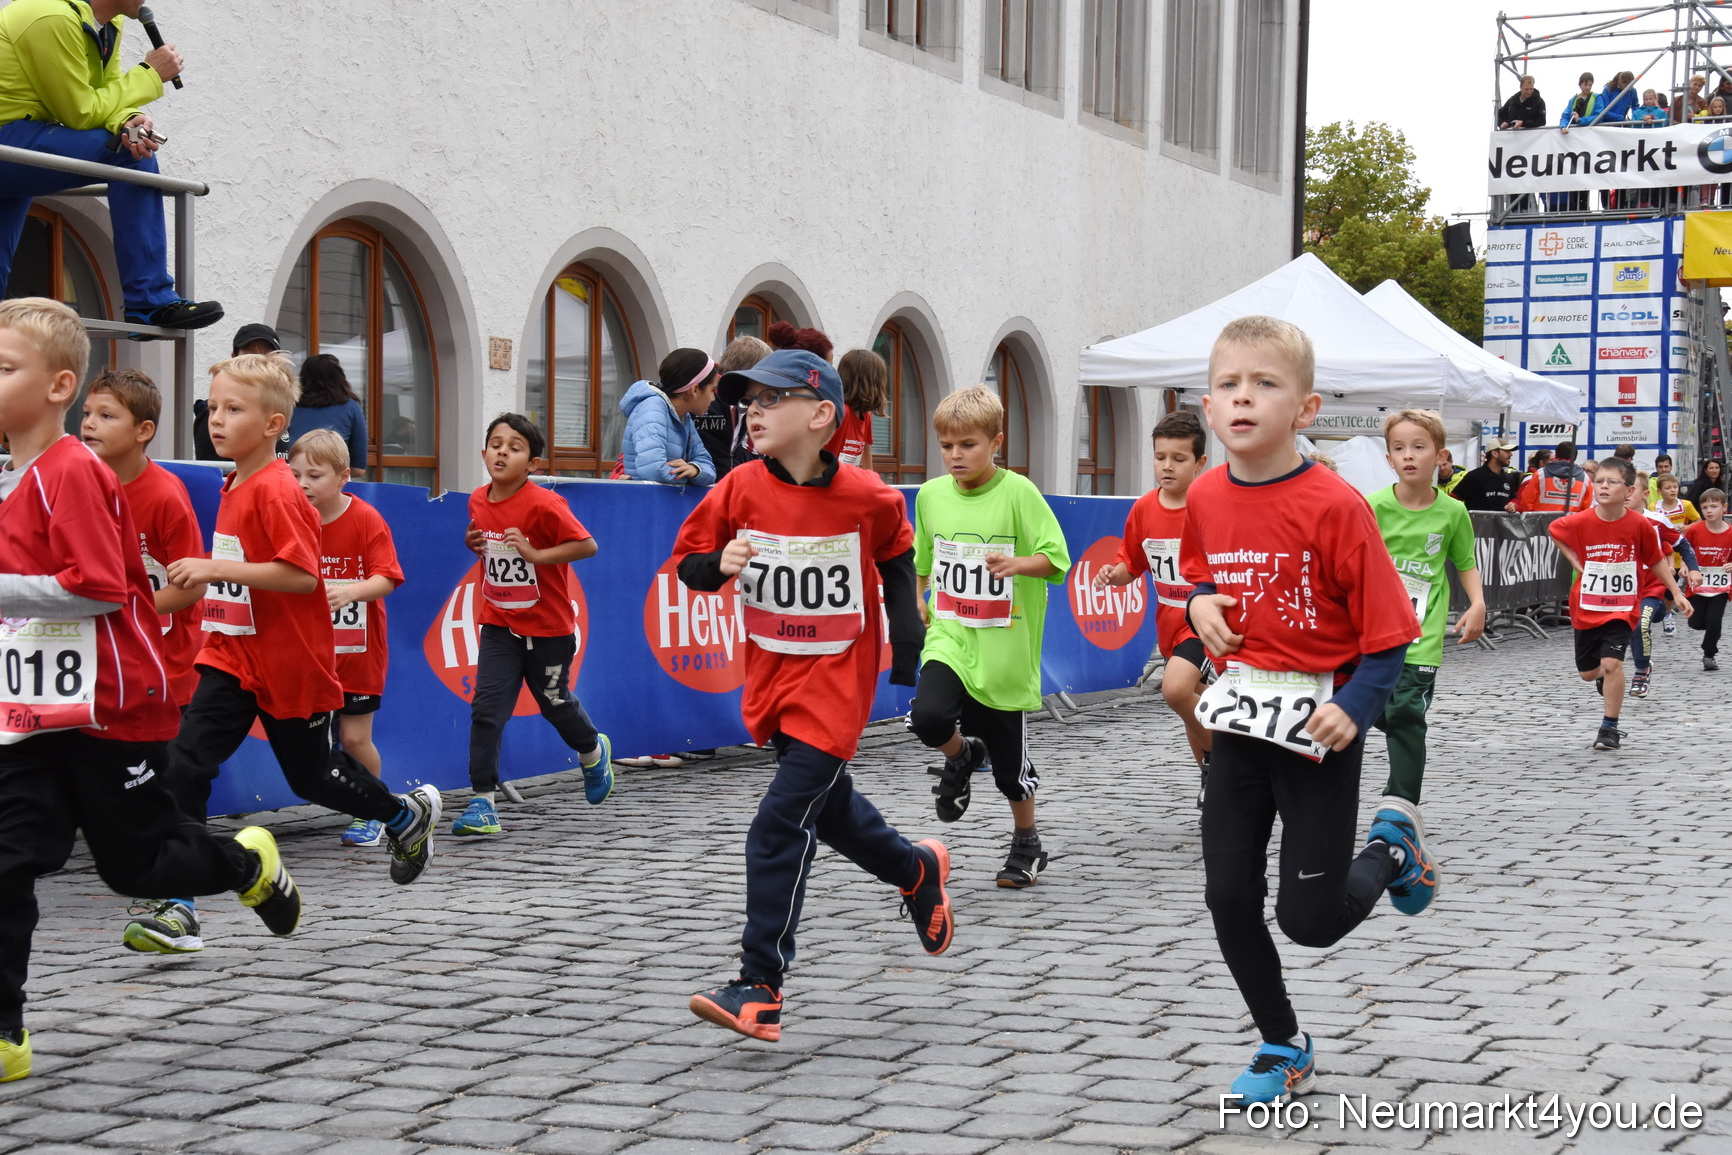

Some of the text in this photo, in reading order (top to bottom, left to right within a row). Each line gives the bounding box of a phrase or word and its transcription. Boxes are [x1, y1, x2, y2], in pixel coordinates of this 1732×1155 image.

[1488, 139, 1677, 179] Neumarkt
[1547, 314, 1588, 322] VARIOTEC
[1618, 391, 1635, 399] Braun
[694, 418, 726, 430] CAMP
[1529, 424, 1565, 434] swn
[787, 539, 852, 555] BOCK
[1585, 543, 1620, 551] Neumarkter
[1206, 548, 1269, 565] eumarkter
[749, 561, 851, 609] 7003
[1588, 573, 1633, 593] 7196
[1701, 573, 1728, 586] 126
[1301, 551, 1318, 629] BAMBINI
[853, 603, 858, 611] K
[956, 601, 978, 616] Toni
[777, 620, 817, 638] Jona
[1084, 619, 1118, 634] SPORTS
[671, 652, 727, 673] SPORTS
[0, 648, 82, 697] 018
[1251, 668, 1321, 687] BOCK
[82, 693, 88, 701] K
[6, 709, 43, 729] Felix
[1314, 746, 1320, 755] K
[124, 769, 155, 790] erima
[927, 904, 945, 941] PUMA
